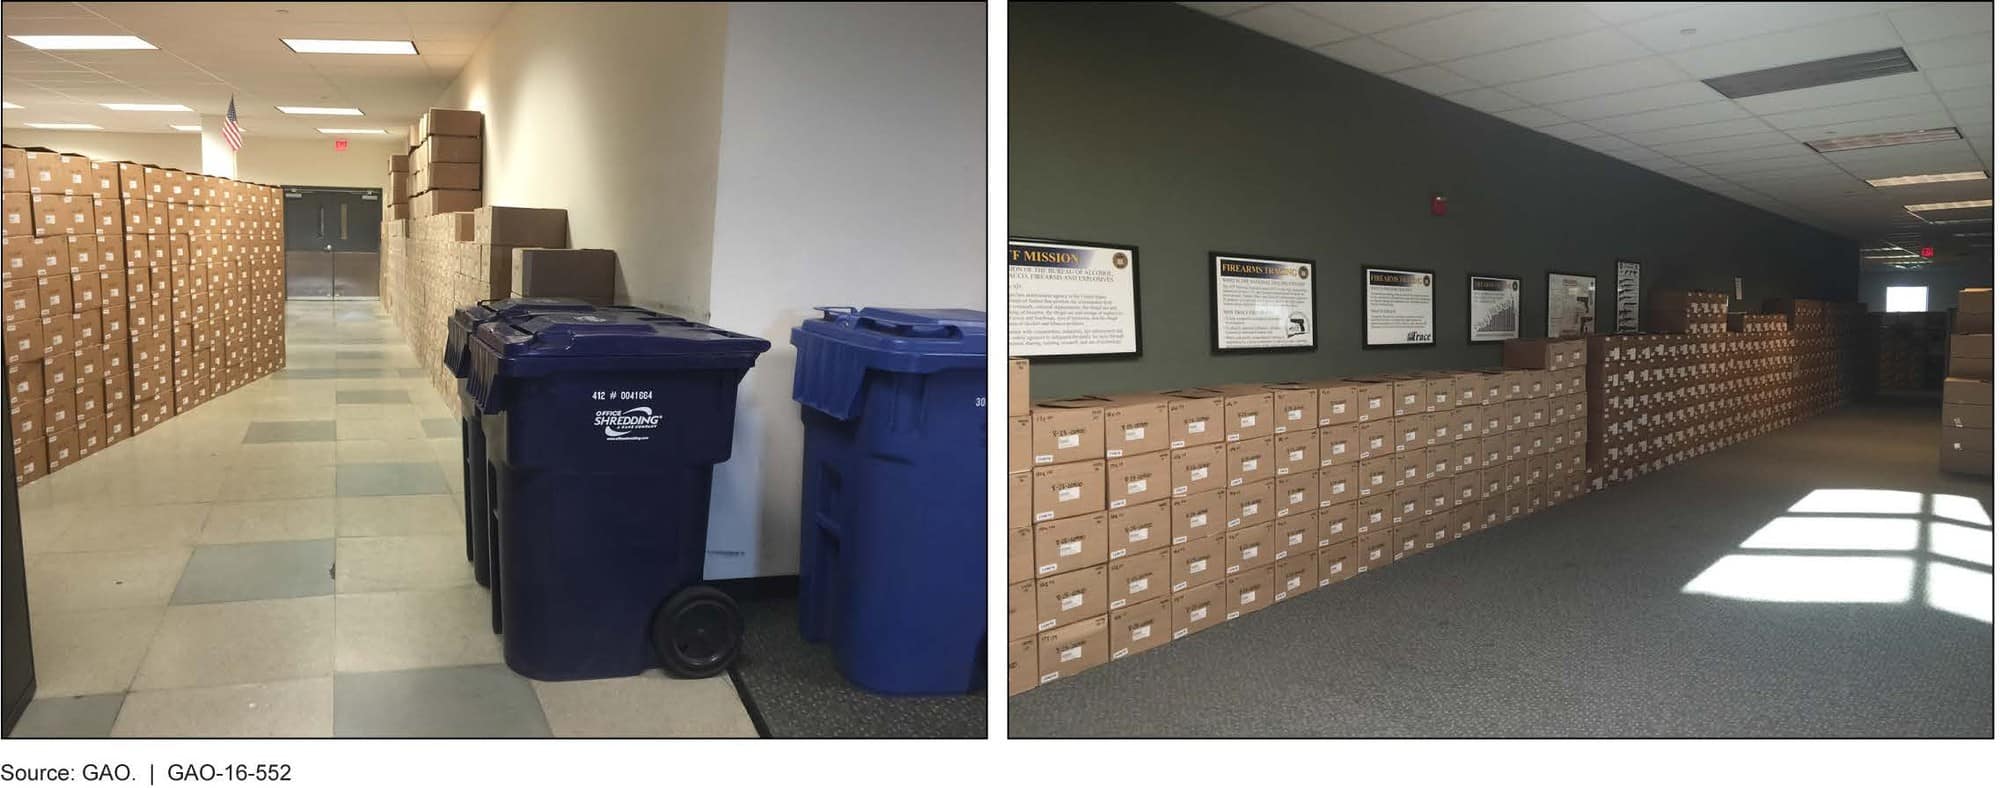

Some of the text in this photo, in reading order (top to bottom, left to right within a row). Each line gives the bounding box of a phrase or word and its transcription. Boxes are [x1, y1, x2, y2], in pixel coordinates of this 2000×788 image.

[1024, 251, 1079, 265] MISSION
[1222, 263, 1263, 273] FIREARMS
[592, 391, 605, 400] 412
[610, 391, 617, 400] #
[594, 415, 659, 426] SHREDDING
